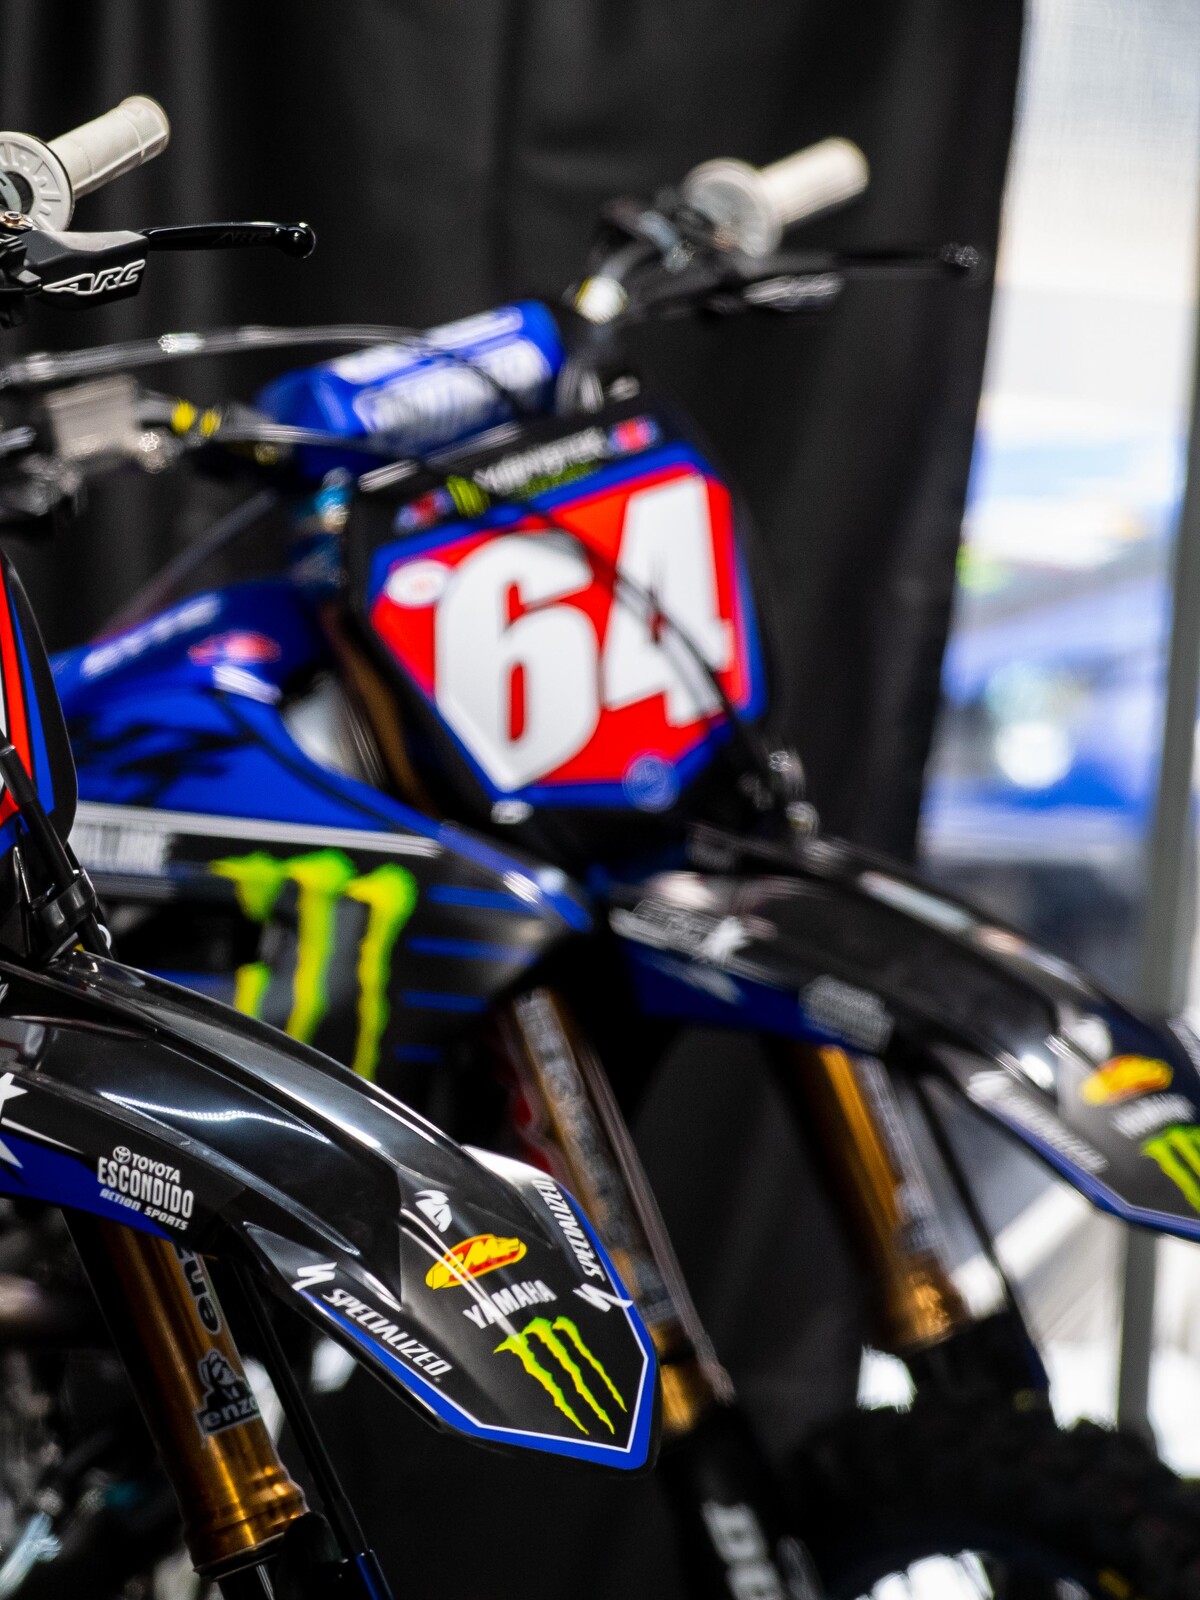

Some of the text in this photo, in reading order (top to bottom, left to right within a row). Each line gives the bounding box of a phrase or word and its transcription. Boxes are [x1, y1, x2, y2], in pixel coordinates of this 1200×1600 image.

[43, 259, 147, 296] ARC
[435, 472, 735, 793] 64
[97, 1156, 194, 1219] ESCONDIDO
[131, 1153, 181, 1184] TOYOTA
[143, 1205, 189, 1231] SPORTS
[463, 1279, 558, 1329] YAMAHA
[322, 1287, 454, 1377] SPECIALIZED
